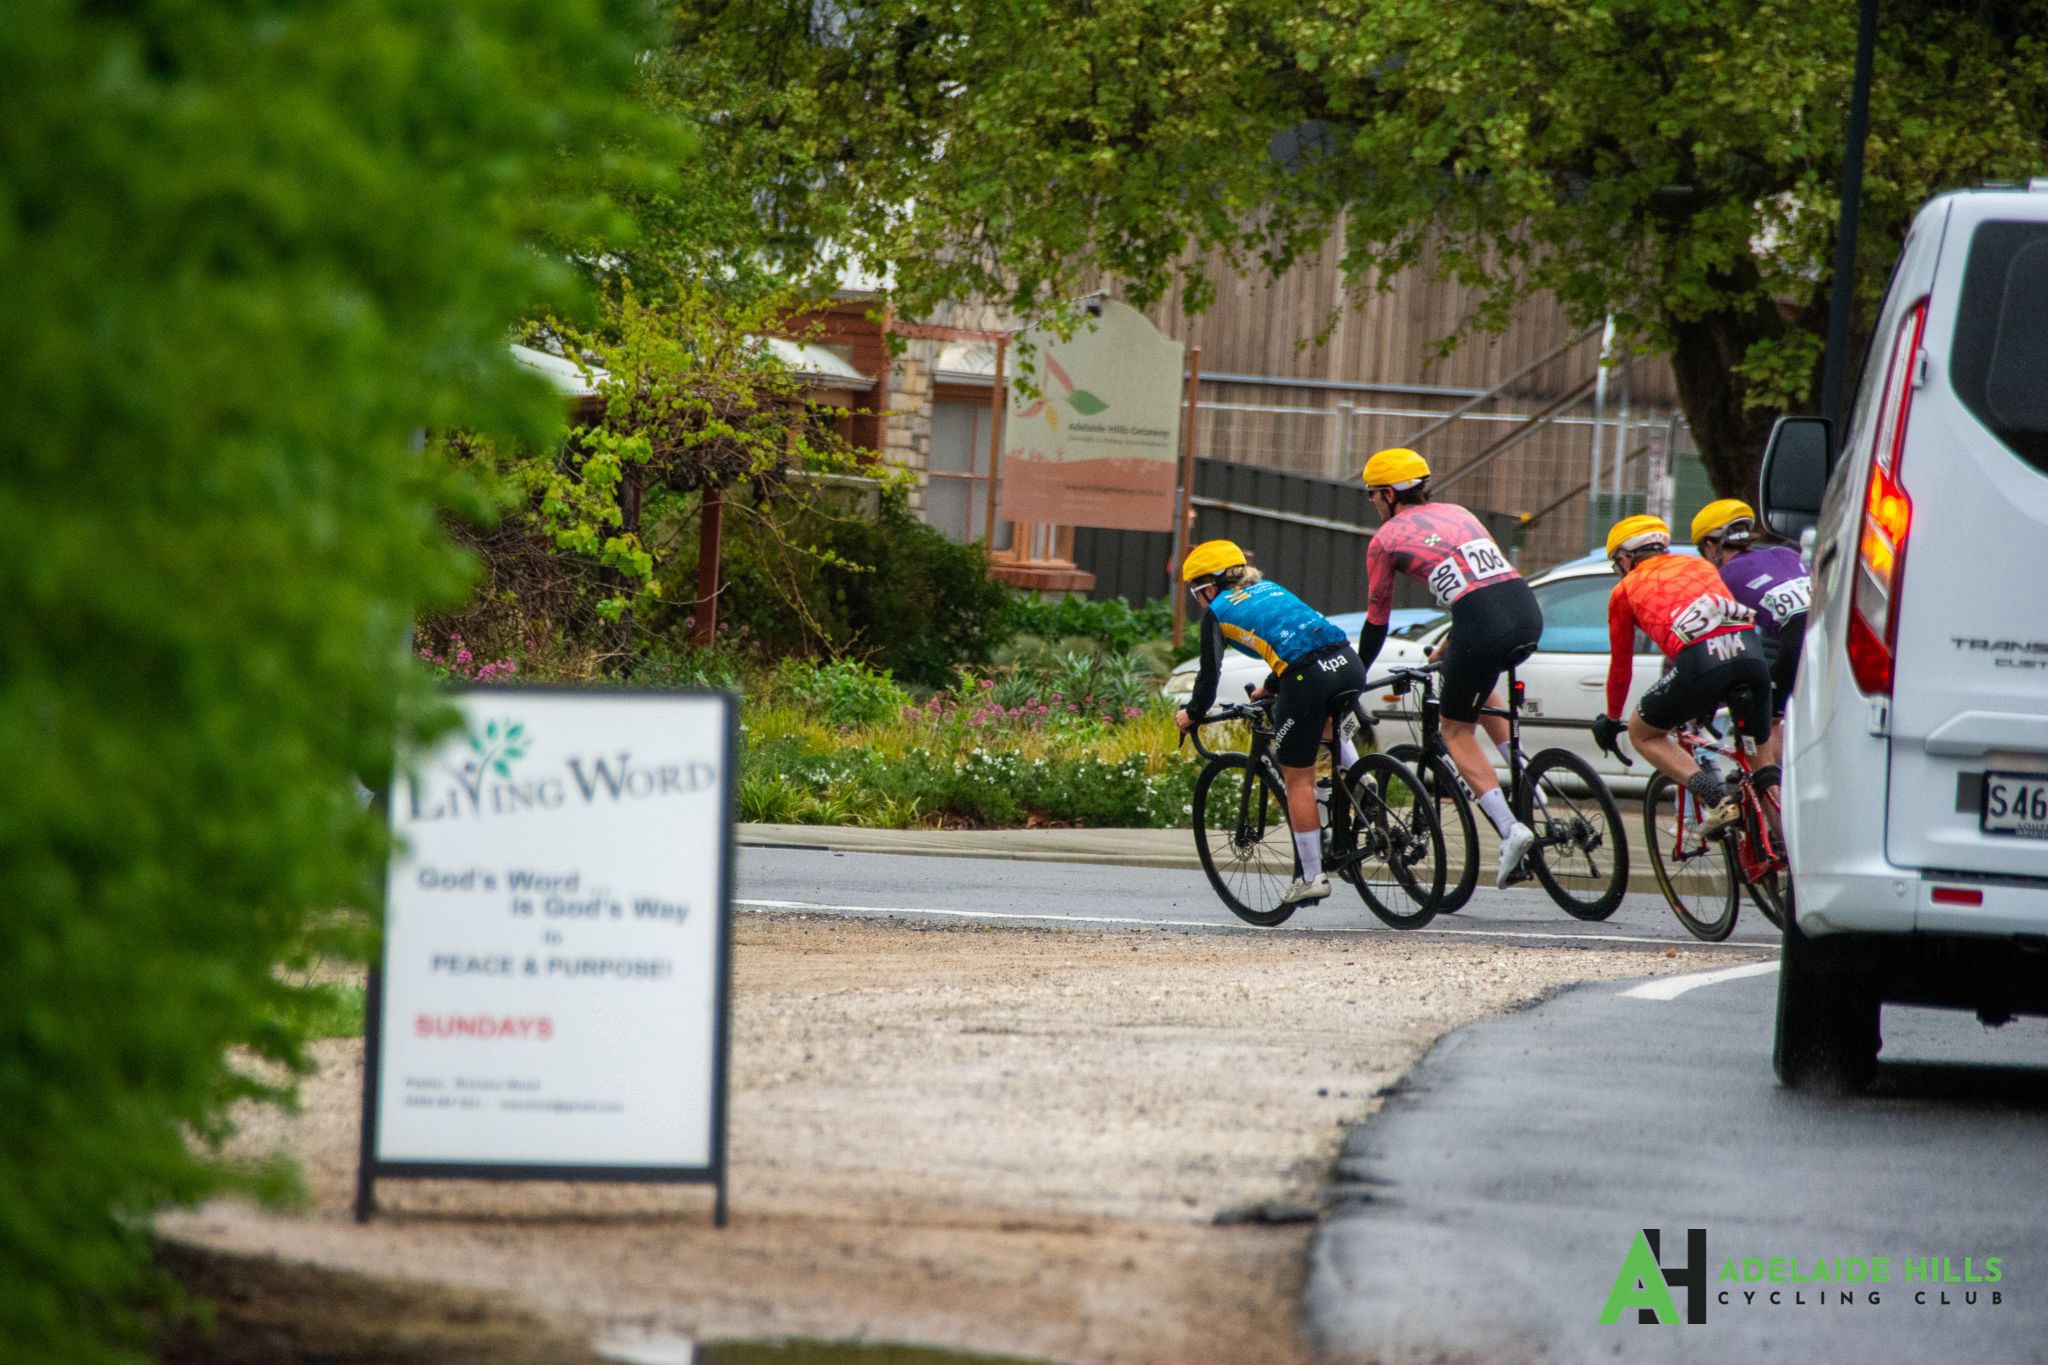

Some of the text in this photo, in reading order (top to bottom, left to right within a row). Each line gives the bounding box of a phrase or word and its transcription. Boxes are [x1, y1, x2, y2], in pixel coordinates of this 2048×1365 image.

[1469, 549, 1505, 575] 206
[1317, 653, 1349, 673] kpa
[418, 868, 580, 893] God's Word
[544, 899, 622, 919] God's
[633, 900, 690, 925] Way
[433, 956, 514, 976] PEACE
[415, 1016, 553, 1041] SUNDAYS
